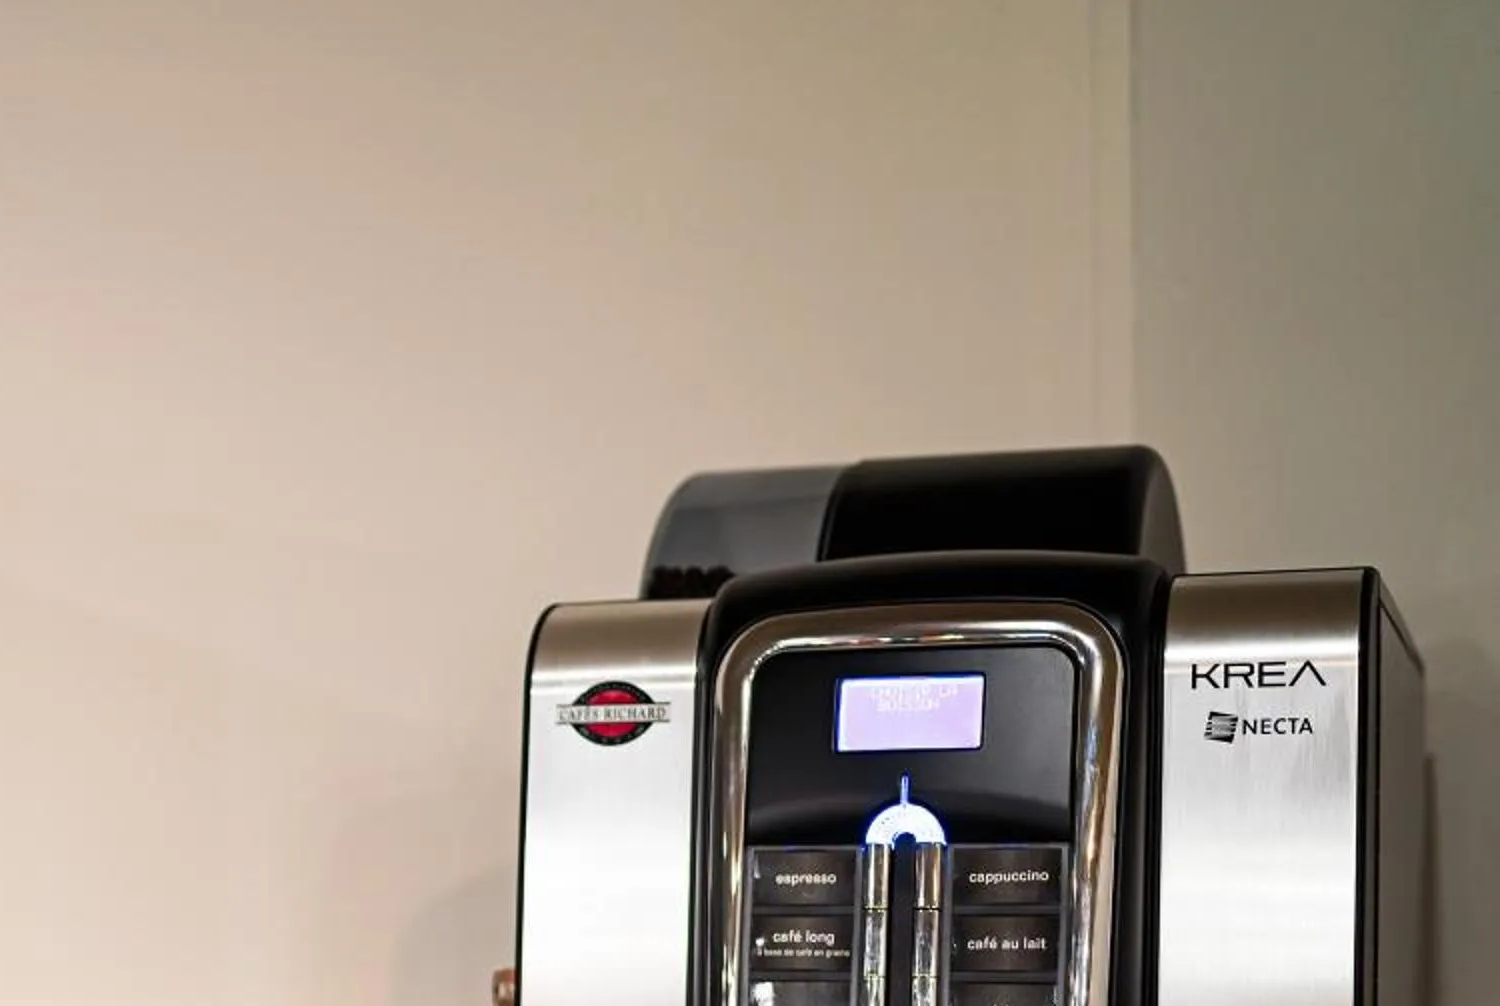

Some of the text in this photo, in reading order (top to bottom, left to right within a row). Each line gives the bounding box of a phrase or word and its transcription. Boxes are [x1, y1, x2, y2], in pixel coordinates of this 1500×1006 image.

[1191, 660, 1327, 690] KREA
[603, 705, 667, 721] RICHARD
[1242, 717, 1313, 735] NECTA
[775, 873, 837, 887] espresso
[969, 869, 1049, 884] cappuccino
[772, 929, 835, 947] café long
[967, 936, 1047, 950] café au lait
